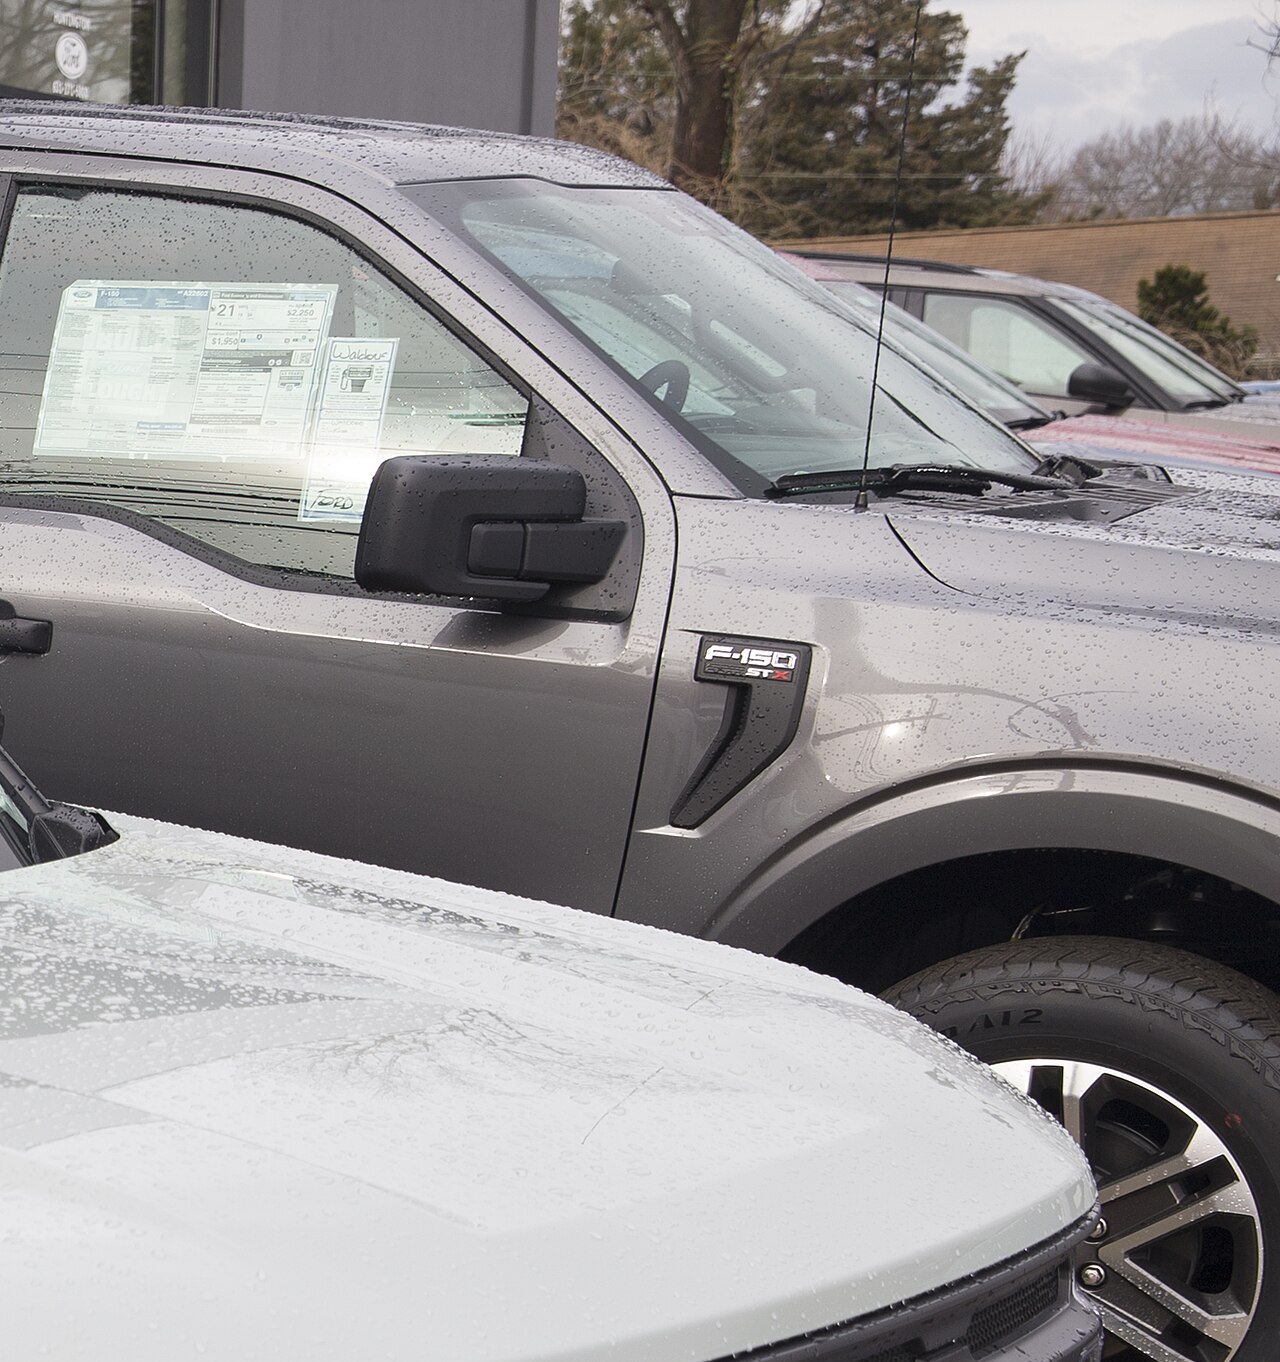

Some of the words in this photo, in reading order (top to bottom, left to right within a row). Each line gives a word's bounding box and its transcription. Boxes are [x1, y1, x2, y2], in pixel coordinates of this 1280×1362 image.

[216, 303, 235, 317] 21
[704, 644, 798, 670] F-150
[745, 667, 790, 680] STX
